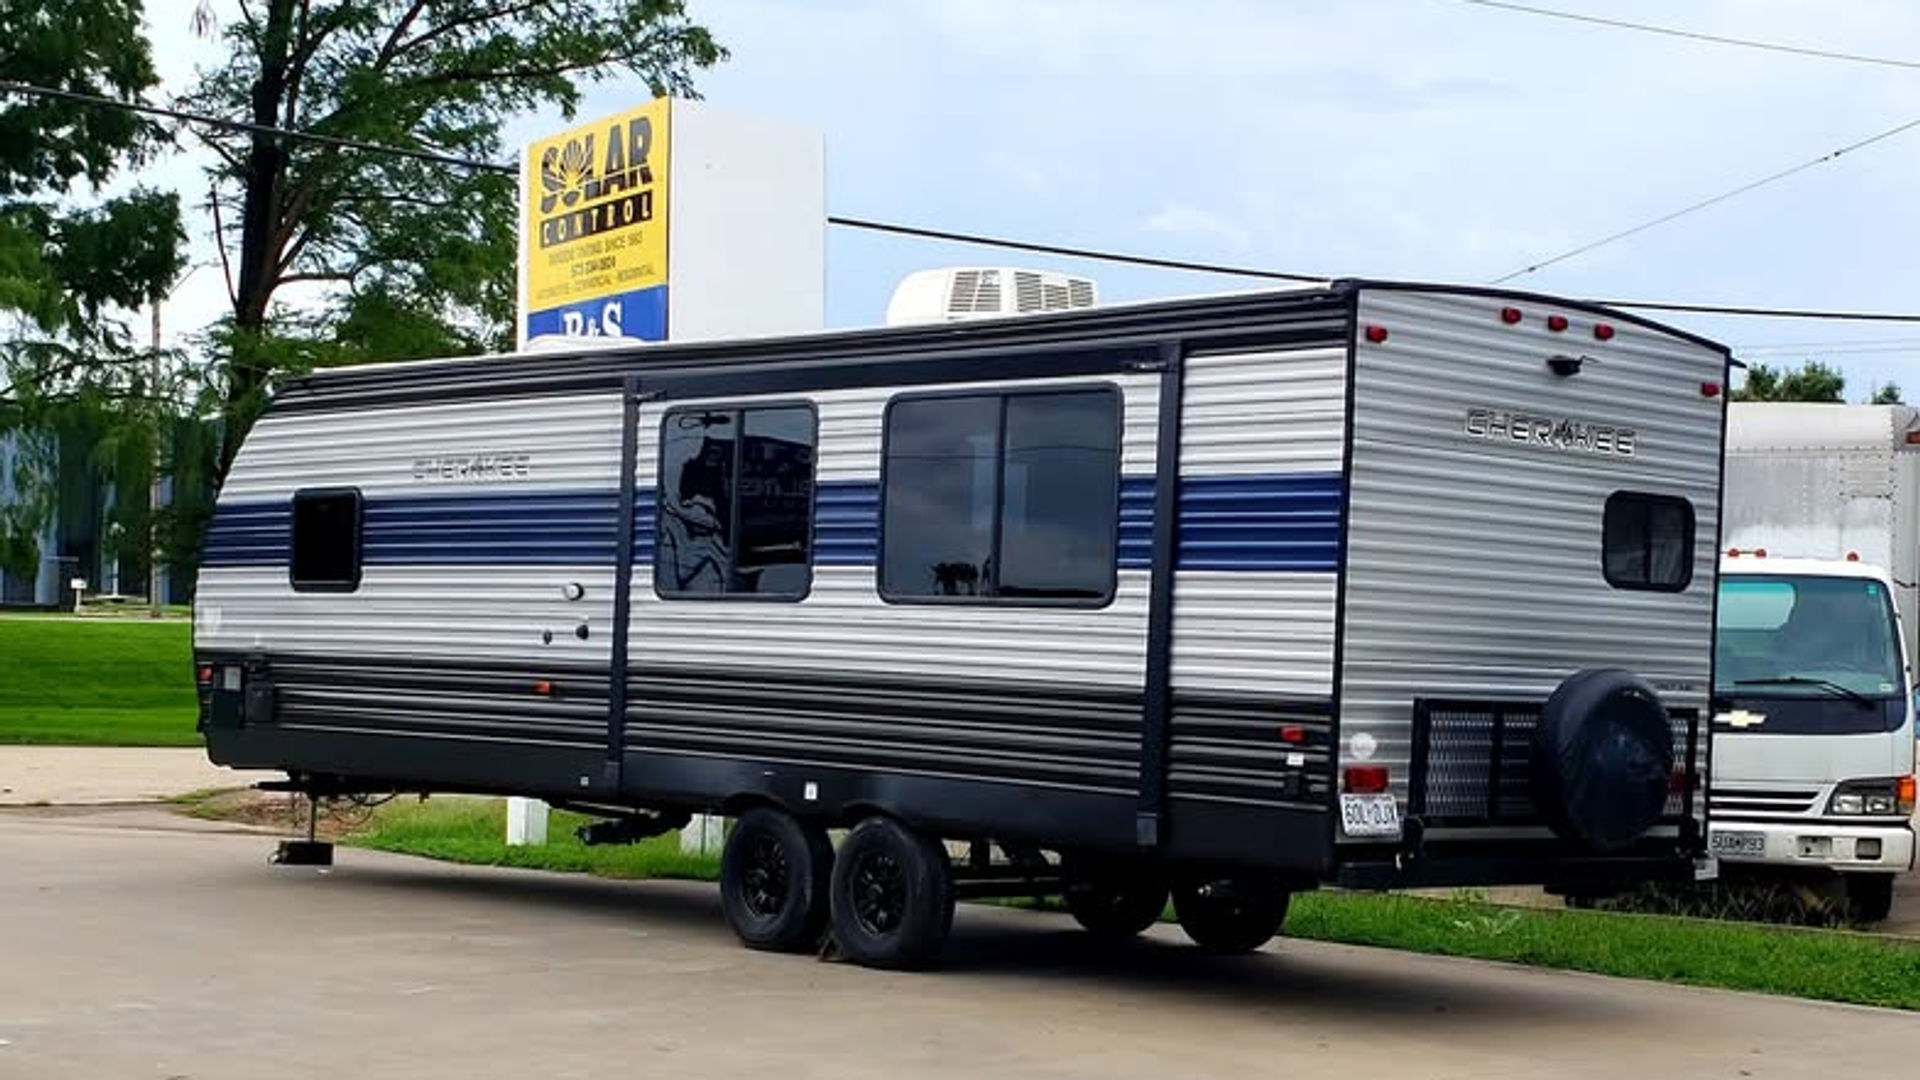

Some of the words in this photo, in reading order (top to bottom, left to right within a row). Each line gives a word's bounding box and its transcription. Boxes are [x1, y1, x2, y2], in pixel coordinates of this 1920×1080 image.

[541, 116, 653, 213] SOLAR
[542, 192, 651, 246] CONTROL
[1467, 408, 1636, 456] CHEROKEE
